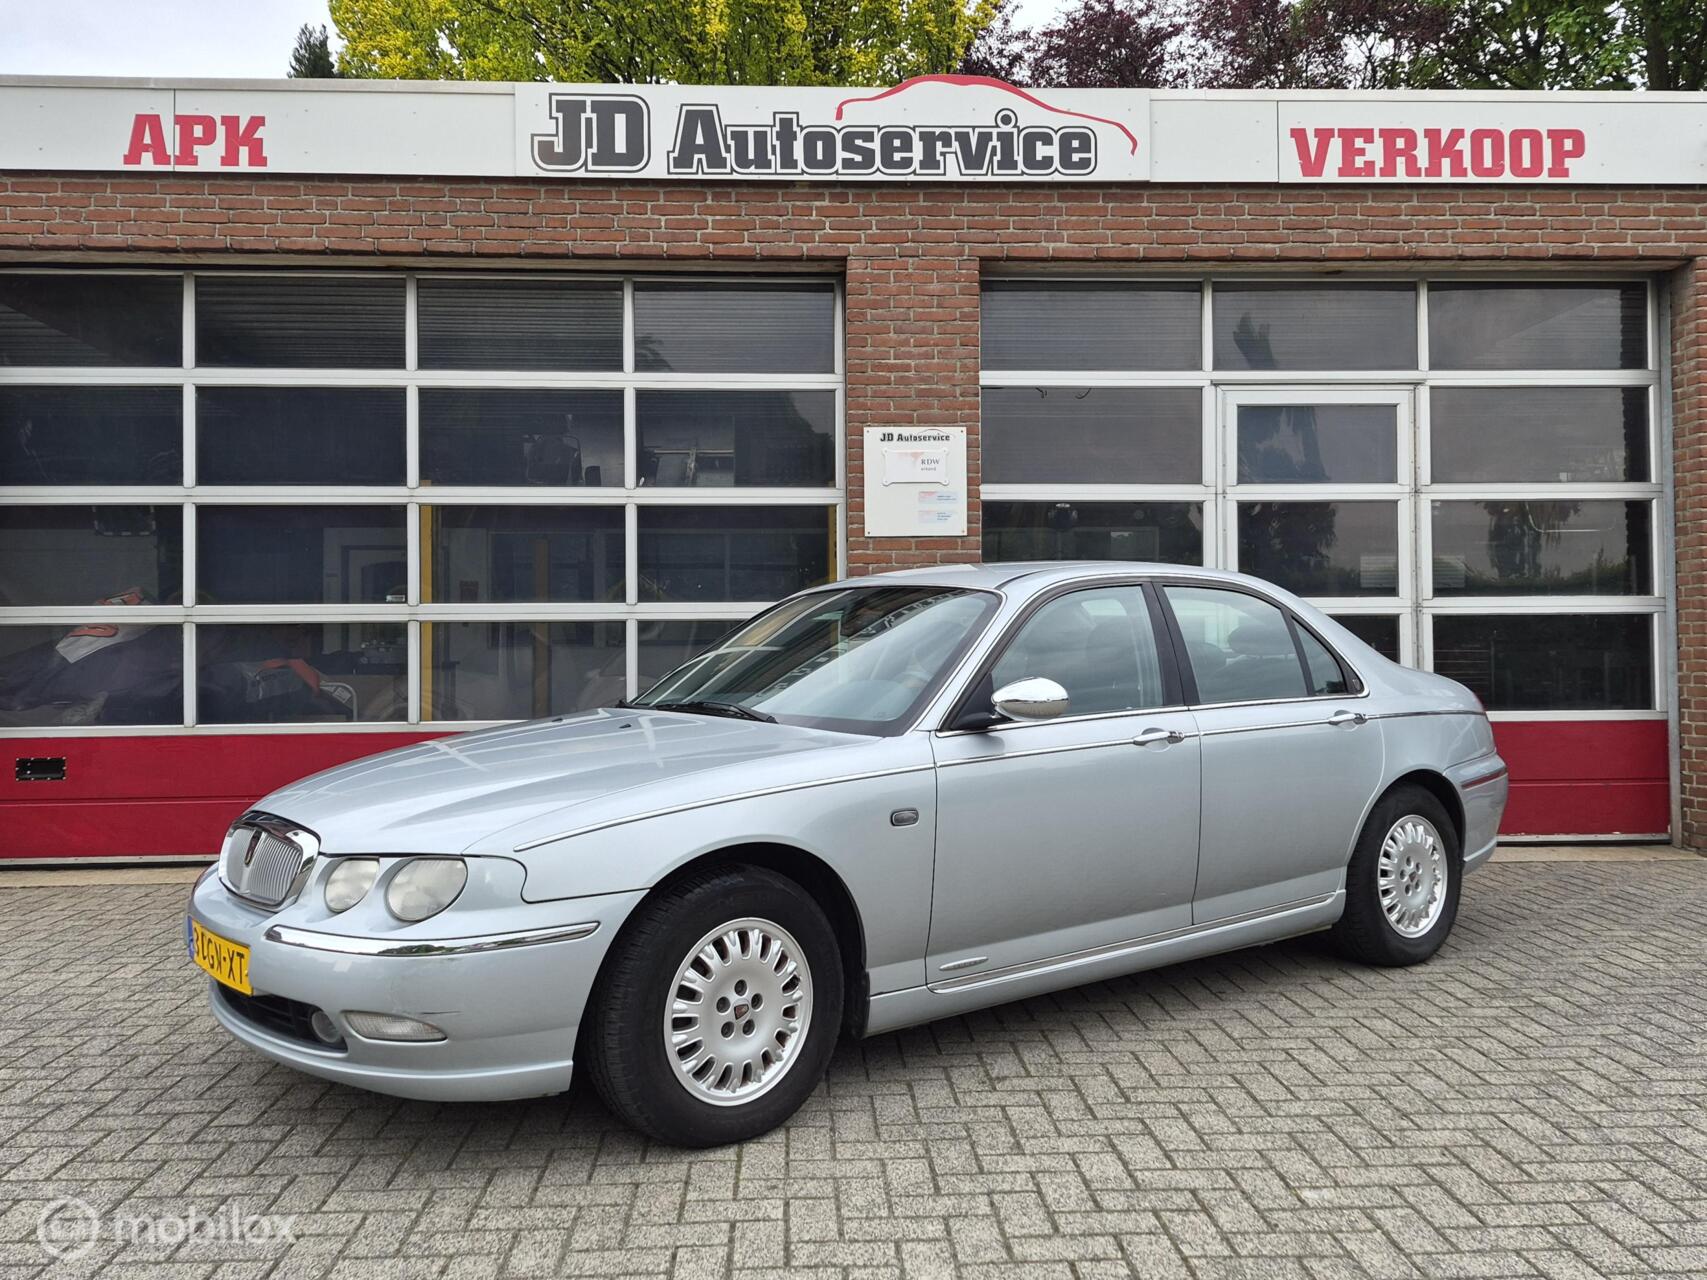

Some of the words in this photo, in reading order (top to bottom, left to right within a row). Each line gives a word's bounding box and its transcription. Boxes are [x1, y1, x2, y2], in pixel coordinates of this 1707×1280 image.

[123, 114, 268, 167] APK
[530, 93, 651, 174] JD
[667, 103, 1098, 177] Autoservice
[1290, 128, 1586, 178] VERKOOP
[880, 433, 894, 442] JD
[897, 433, 950, 442] Autoservice
